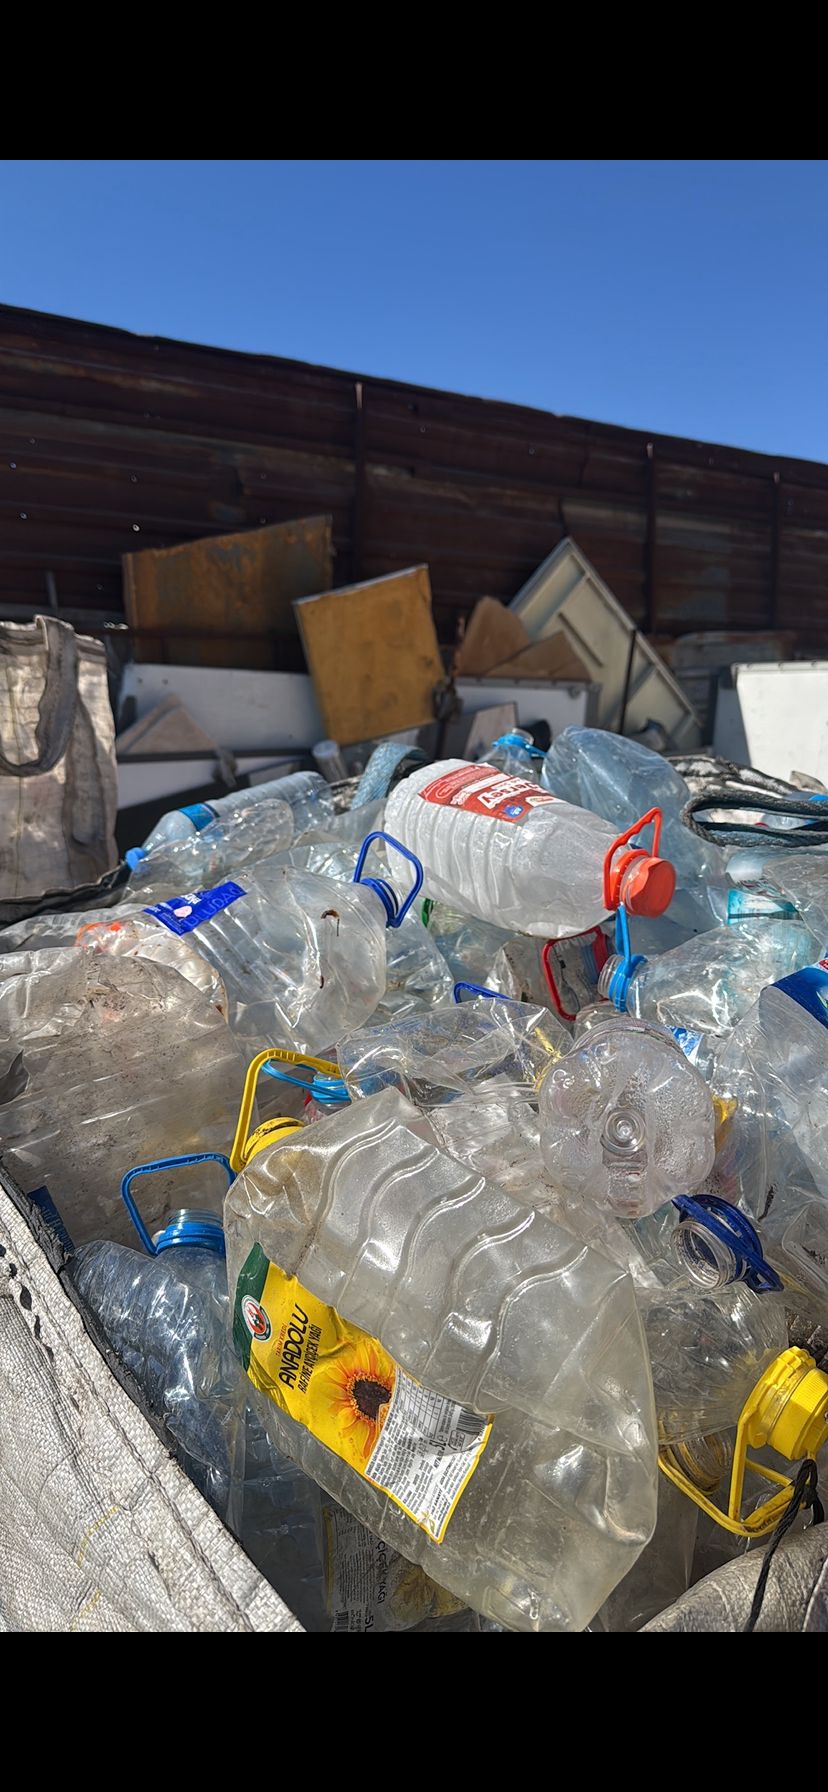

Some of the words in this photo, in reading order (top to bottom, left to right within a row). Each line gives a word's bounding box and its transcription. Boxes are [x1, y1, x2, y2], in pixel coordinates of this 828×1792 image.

[308, 1323, 322, 1341] YAĞI
[278, 1303, 308, 1389] ANADOLU
[305, 1341, 318, 1368] AYÇİÇEK
[297, 1366, 312, 1393] RAFİNE
